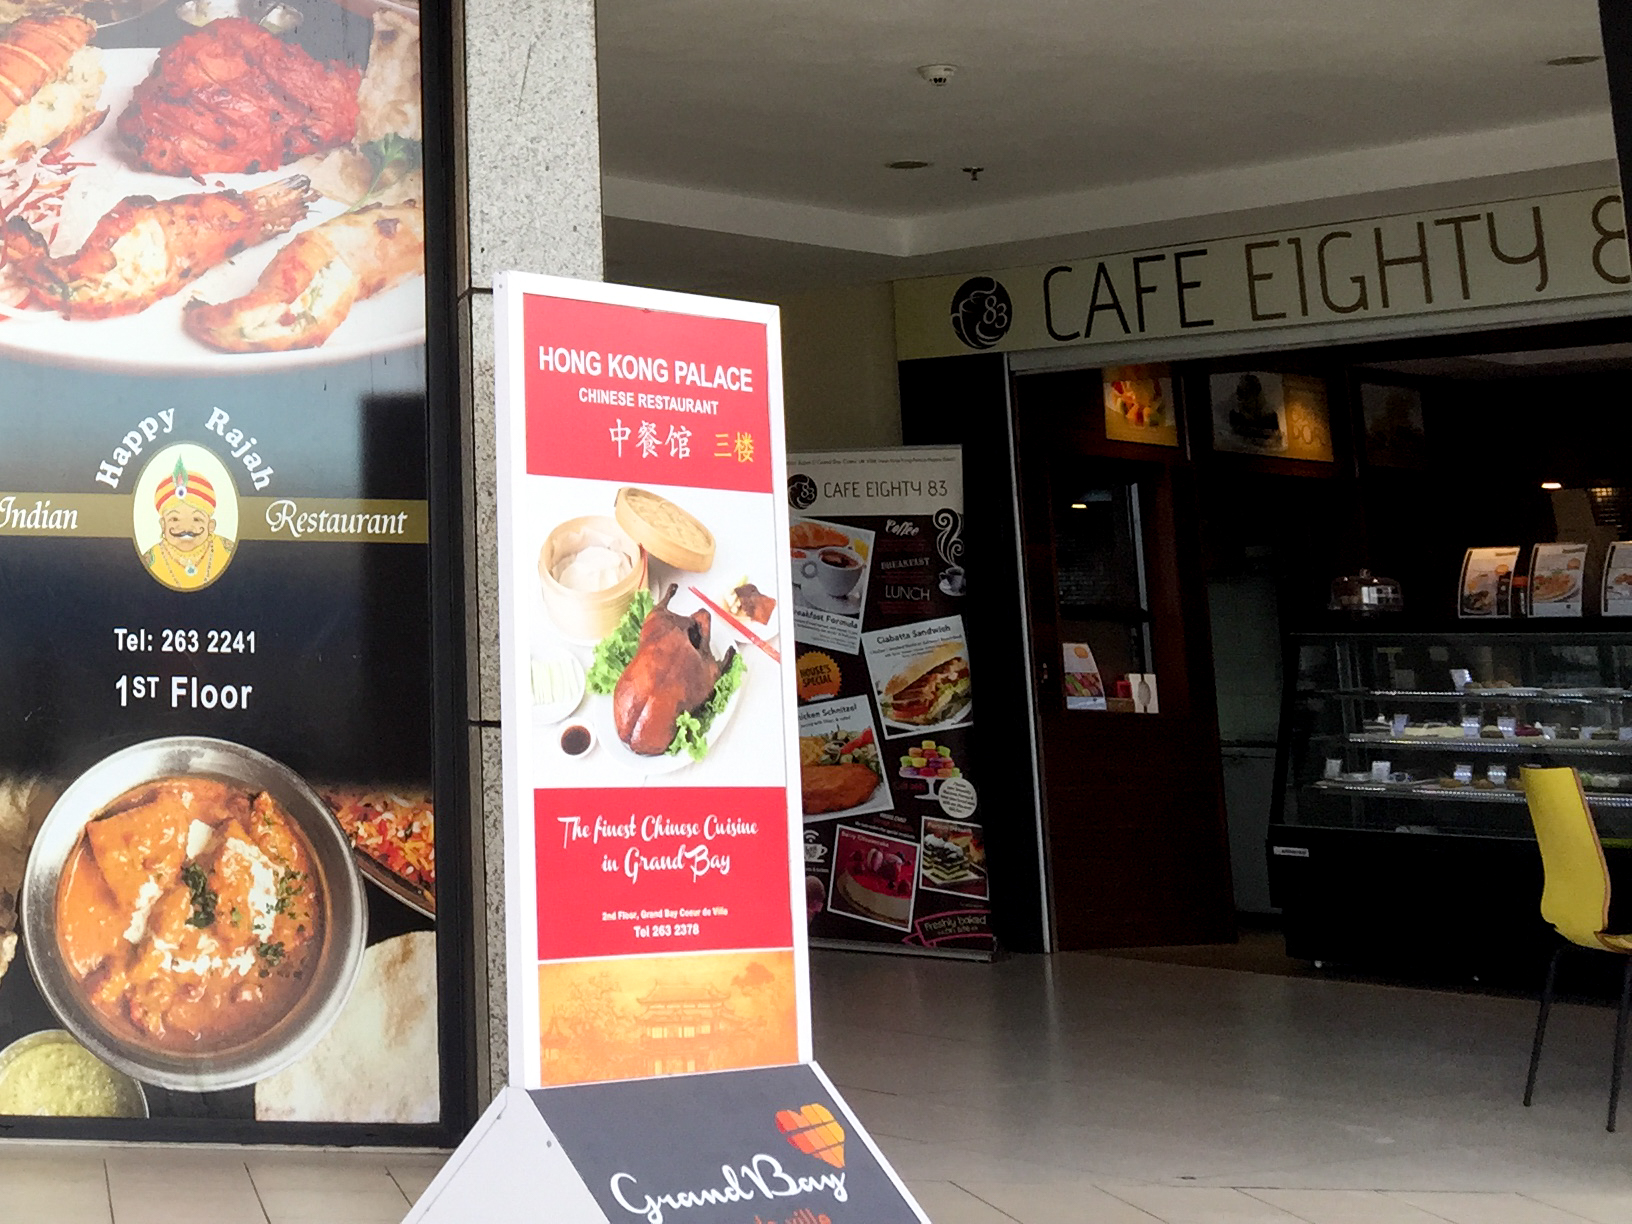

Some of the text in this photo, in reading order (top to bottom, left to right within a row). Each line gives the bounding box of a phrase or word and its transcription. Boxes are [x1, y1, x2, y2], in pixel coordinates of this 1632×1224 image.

[1042, 248, 1215, 342] CAFE
[538, 346, 753, 392] HONG KONG PALACE
[578, 387, 719, 415] CHINESE RESTAURANT
[95, 406, 276, 491] Happy Rajah
[609, 418, 754, 463] 中餐馆 三楼
[824, 481, 860, 498] CAFE
[928, 480, 948, 496] 83
[265, 499, 408, 538] Restaurant
[885, 585, 930, 602] LUNCH
[794, 609, 824, 622] reakfast
[114, 628, 256, 654] Tel: 263 2241
[912, 624, 951, 639] Sandwich
[115, 675, 252, 709] 1ST Floor
[557, 813, 759, 849] The finest Chinese Cuisine
[601, 844, 730, 884] in Grand Bay
[601, 911, 617, 921] 2nd
[640, 909, 663, 919] Grand
[664, 908, 678, 919] Bay
[679, 908, 701, 917] Coeur
[702, 907, 712, 916] de
[712, 906, 728, 916] Ville
[633, 923, 700, 938] Tel 263 2378
